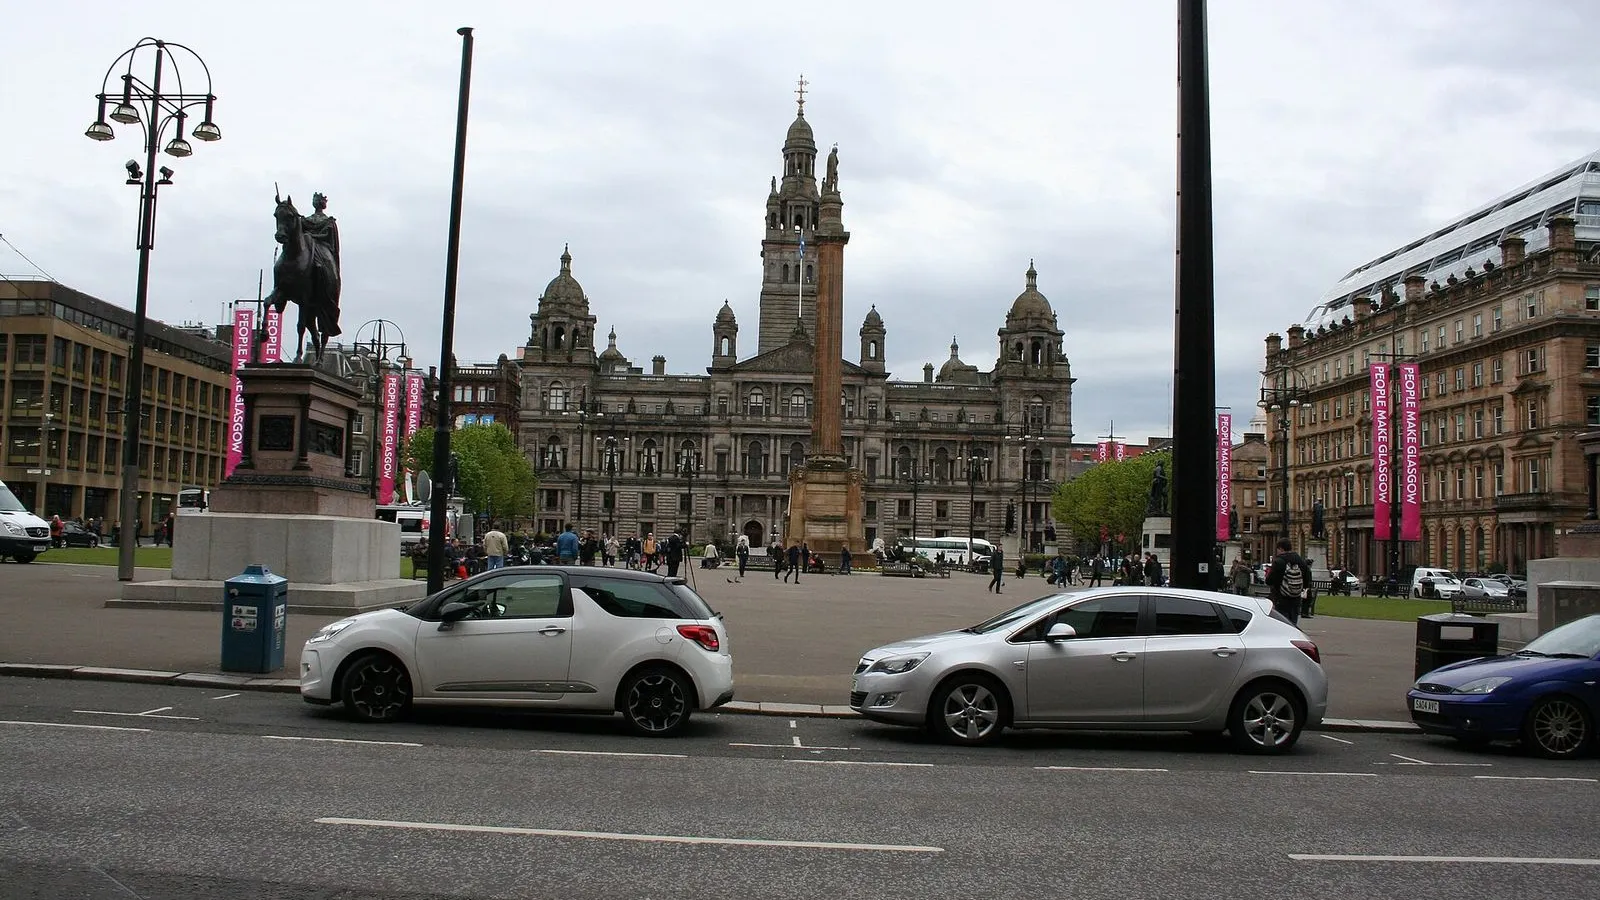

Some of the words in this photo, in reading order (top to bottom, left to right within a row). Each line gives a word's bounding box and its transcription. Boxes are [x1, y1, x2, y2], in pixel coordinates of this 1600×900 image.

[238, 313, 249, 356] PEOPLE
[266, 312, 279, 355] PEOPLE
[236, 358, 247, 392] ME
[387, 377, 397, 409] PEOPLE
[409, 377, 419, 409] PEOPLE
[1374, 366, 1387, 407] PEOPLE
[1403, 367, 1416, 408] PEOPLE
[232, 394, 244, 453] GLASGOW
[385, 410, 395, 434] MAKE
[408, 410, 417, 435] MAKE
[1221, 416, 1229, 446] PEOPLE
[1376, 409, 1388, 442] MAKE
[1406, 410, 1417, 444] MAKE
[383, 435, 394, 479] GLASGOW
[1221, 448, 1229, 472] MAKE
[1377, 444, 1388, 503] GLASGOW
[1406, 445, 1417, 504] GLASGOW
[1220, 472, 1229, 516] GLASGOW
